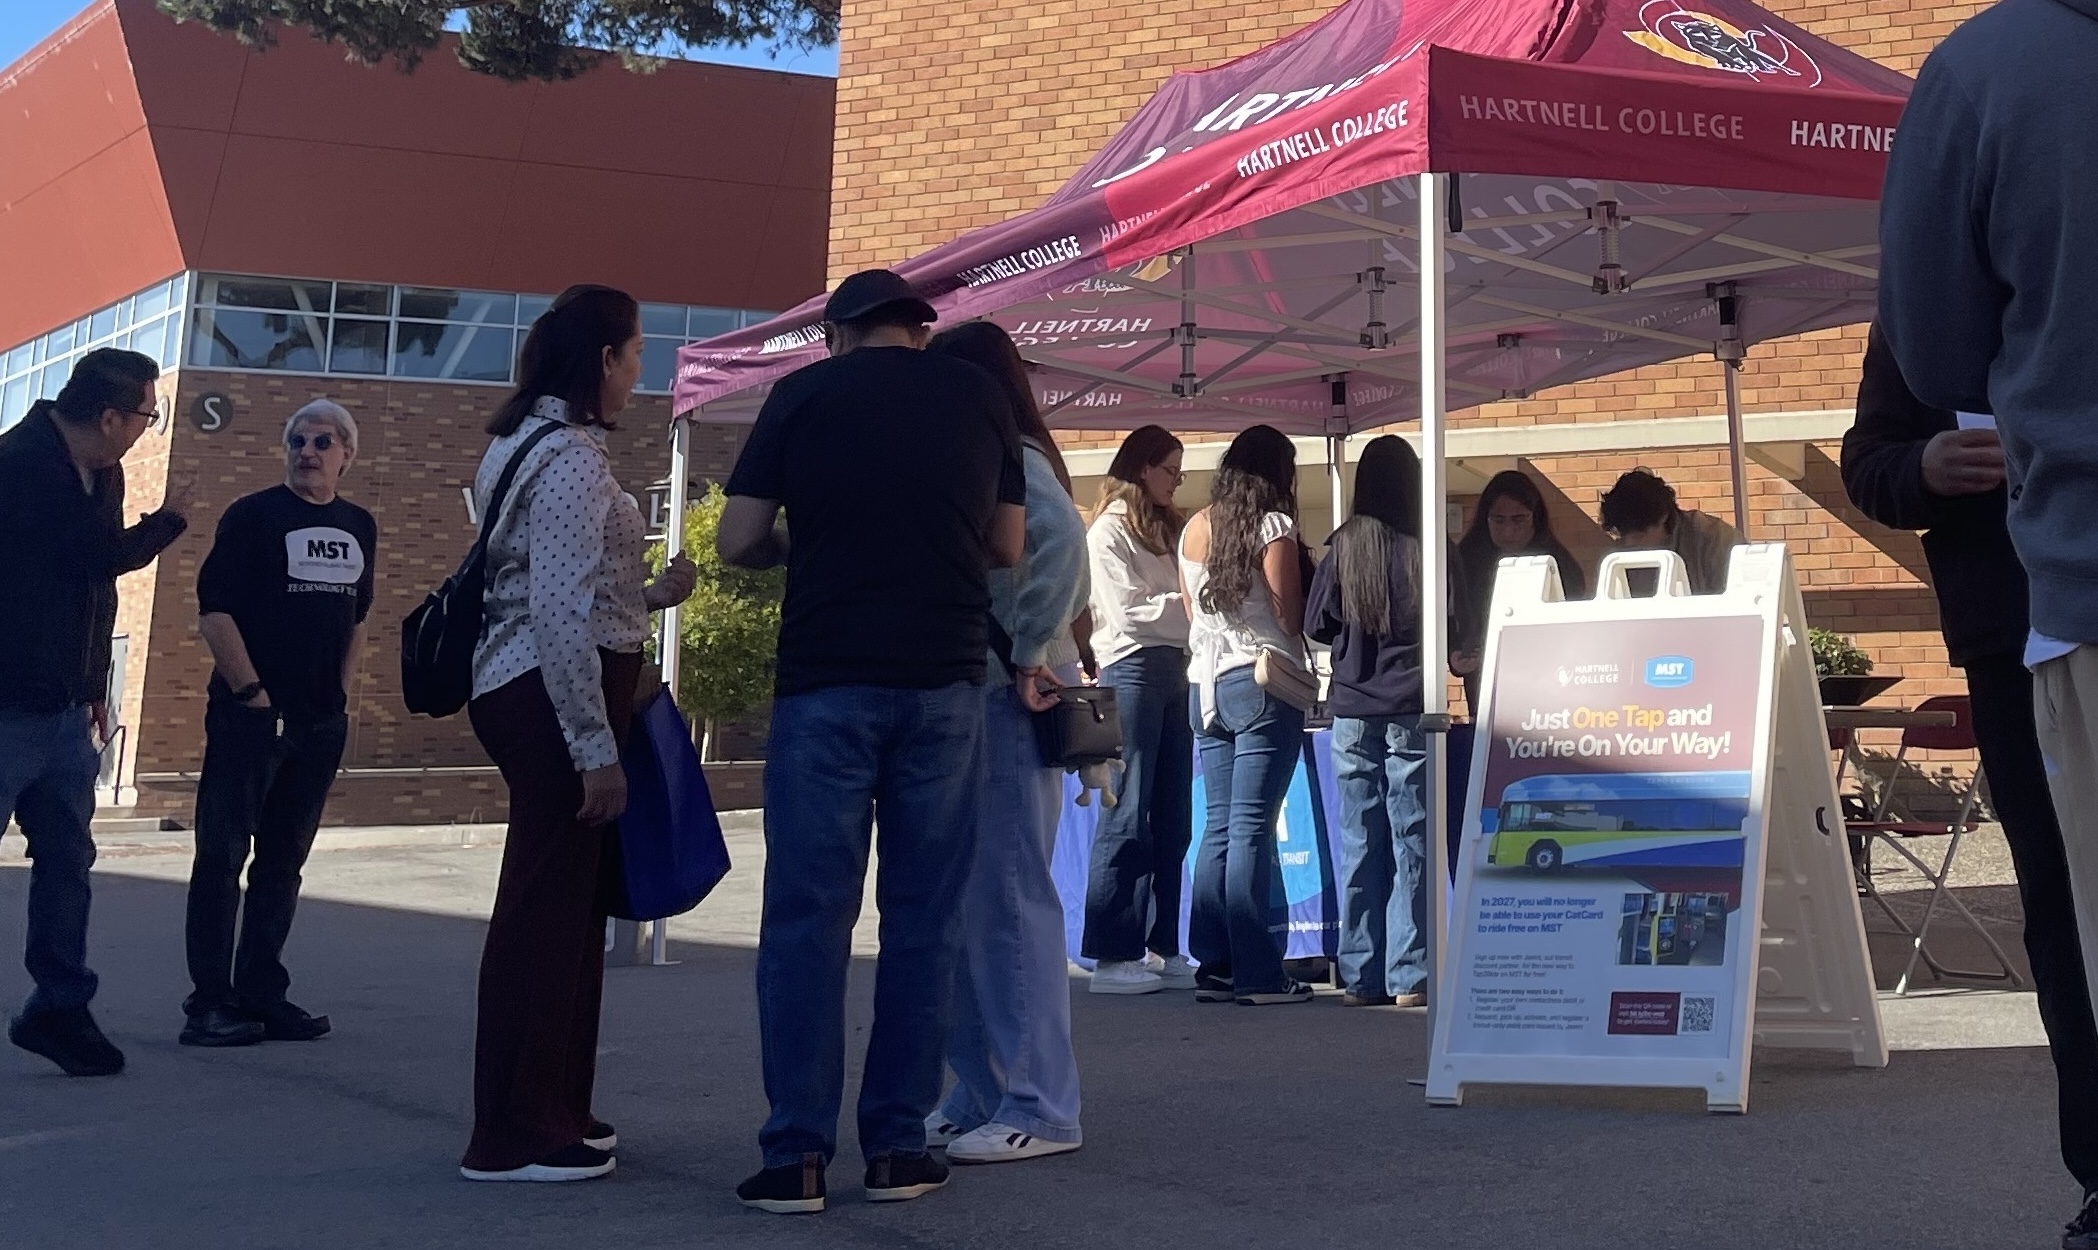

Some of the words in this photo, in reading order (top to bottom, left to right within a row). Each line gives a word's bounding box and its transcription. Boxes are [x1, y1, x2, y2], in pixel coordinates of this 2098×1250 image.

[1460, 94, 1609, 131] HARTNELL
[1618, 107, 1745, 141] COLLEGE
[1237, 127, 1331, 178] HARTNELL
[1331, 99, 1409, 148] COLLEGE
[1790, 120, 1898, 153] HARTNE
[957, 255, 1024, 288] HARTNELL
[1022, 235, 1082, 270] COLLEGE
[203, 397, 221, 431] S
[307, 540, 349, 560] MST
[1574, 674, 1619, 685] COLLEGE
[1575, 664, 1619, 673] HARTNELL
[1655, 663, 1684, 676] MST
[1521, 708, 1570, 731] Just
[1573, 706, 1619, 729] One
[1622, 705, 1665, 732] Tap
[1667, 703, 1712, 727] and
[1506, 735, 1575, 760] You're
[1578, 734, 1612, 757] On
[1615, 733, 1669, 757] Your
[1671, 731, 1731, 760] Way!
[1481, 897, 1490, 907] In
[1491, 897, 1516, 908] 2027,
[1518, 899, 1535, 908] you
[1537, 897, 1552, 906] will
[1554, 898, 1566, 906] no
[1567, 897, 1597, 908] longer
[1478, 925, 1487, 933] to
[1488, 924, 1506, 933] ride
[1508, 924, 1526, 933] free
[1541, 924, 1563, 933] MST
[1480, 911, 1491, 920] be
[1492, 911, 1511, 920] able
[1514, 911, 1523, 920] to
[1524, 912, 1540, 920] use
[1541, 912, 1562, 922] your
